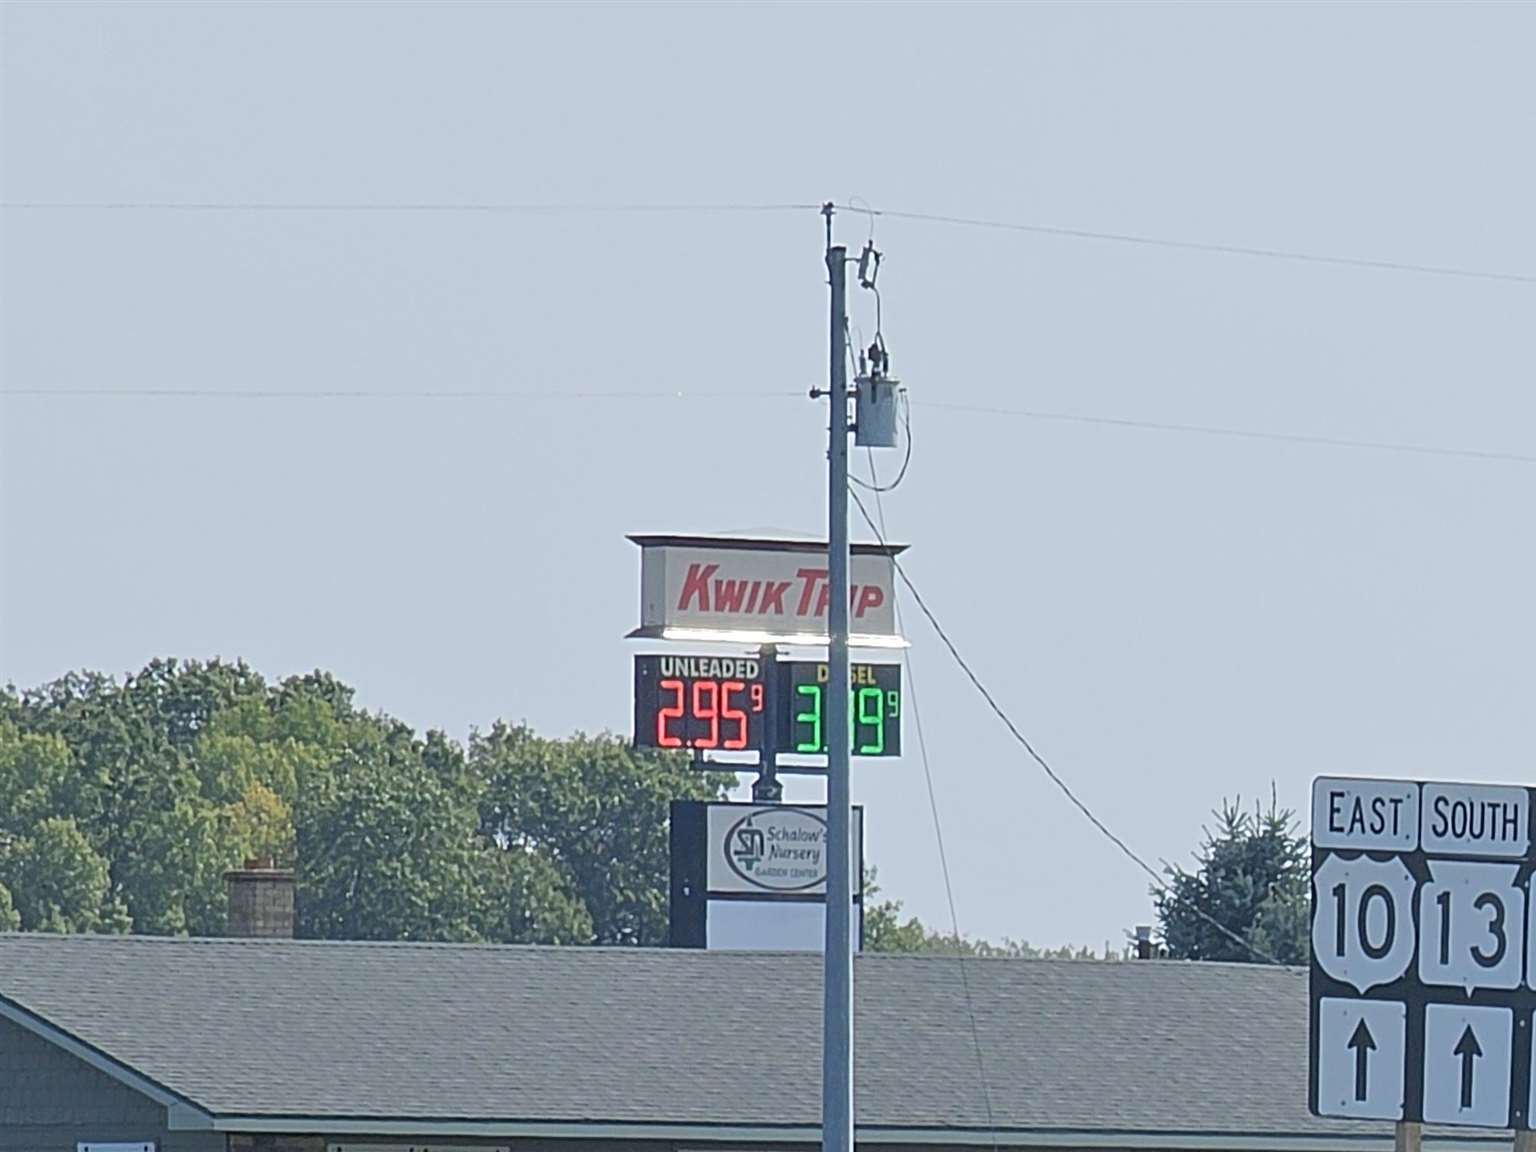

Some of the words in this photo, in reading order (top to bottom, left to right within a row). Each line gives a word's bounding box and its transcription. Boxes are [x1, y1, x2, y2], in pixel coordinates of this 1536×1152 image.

[678, 563, 792, 616] KWIK
[796, 569, 884, 617] TP
[661, 657, 759, 679] UNLEADED
[817, 664, 877, 684] DSEL
[1329, 790, 1403, 838] EAST
[1431, 795, 1519, 842] SOUTH
[769, 844, 820, 865] Nursery
[1331, 882, 1397, 961] 10
[1436, 890, 1508, 969] 13
